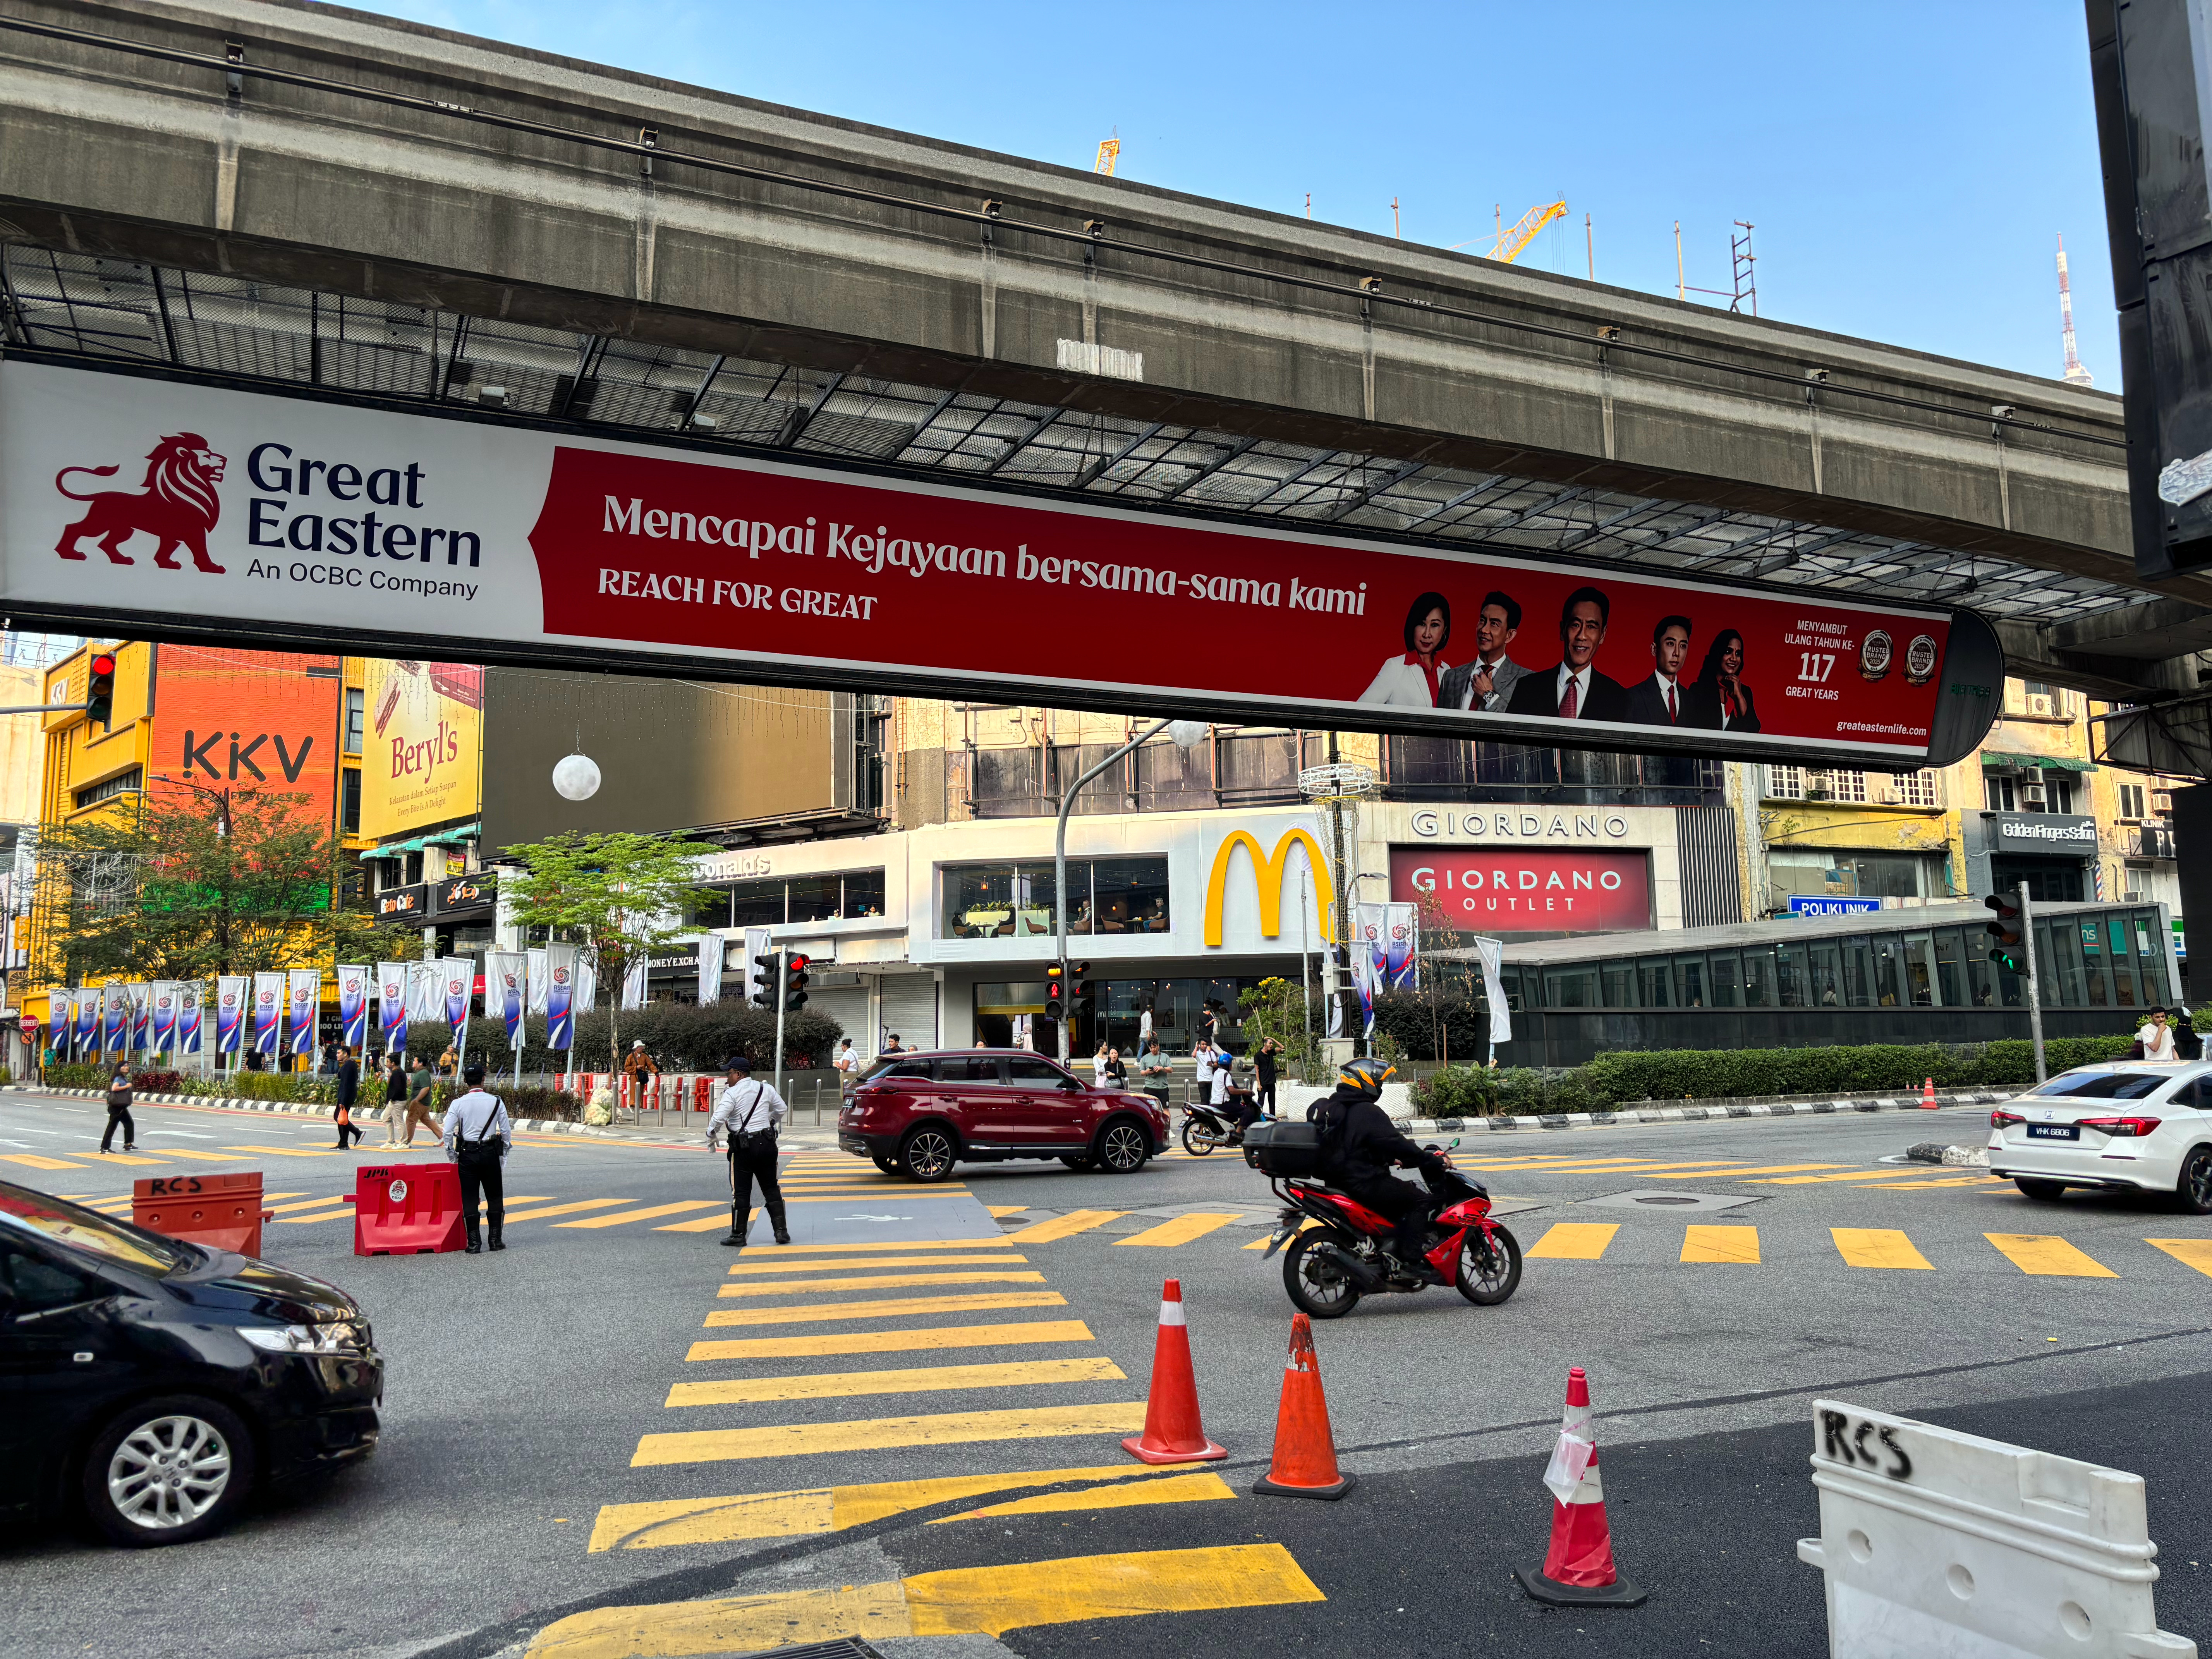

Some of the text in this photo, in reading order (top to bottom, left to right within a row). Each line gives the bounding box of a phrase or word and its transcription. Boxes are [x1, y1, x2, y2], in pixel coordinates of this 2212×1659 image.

[247, 442, 426, 508] Great
[248, 497, 480, 567] Eastern
[603, 495, 1367, 615] Mencapai Kejayaan bersama-sama kami
[247, 558, 478, 601] An OCBC Company
[598, 568, 878, 620] REACH FOR GREAT
[1797, 620, 1848, 635] MENYAMBUT
[1784, 633, 1855, 651] ULANG TAHUN KE-
[1864, 646, 1890, 654] TRUSTED
[1866, 652, 1886, 660] BRAND
[1909, 650, 1934, 659] TRUSTED
[1798, 652, 1836, 682] 117
[1785, 686, 1839, 701] GREAT YEARS
[1836, 721, 1927, 736] greateasternlife.com
[391, 720, 457, 784] Beryl's
[389, 781, 457, 805] Kelazatan dalam Setiap Suapan
[398, 796, 446, 817] Every Bite Is A Delight
[1411, 809, 1628, 837] GIORDANO
[2141, 819, 2165, 828] KLINIK
[1412, 867, 1621, 891] GIORDANO
[1463, 897, 1574, 911] OUTLET
[673, 955, 700, 967] EXCHA
[2050, 1128, 2070, 1136] 6806
[151, 1177, 201, 1195] RCS
[1819, 1408, 1913, 1479] RCS
